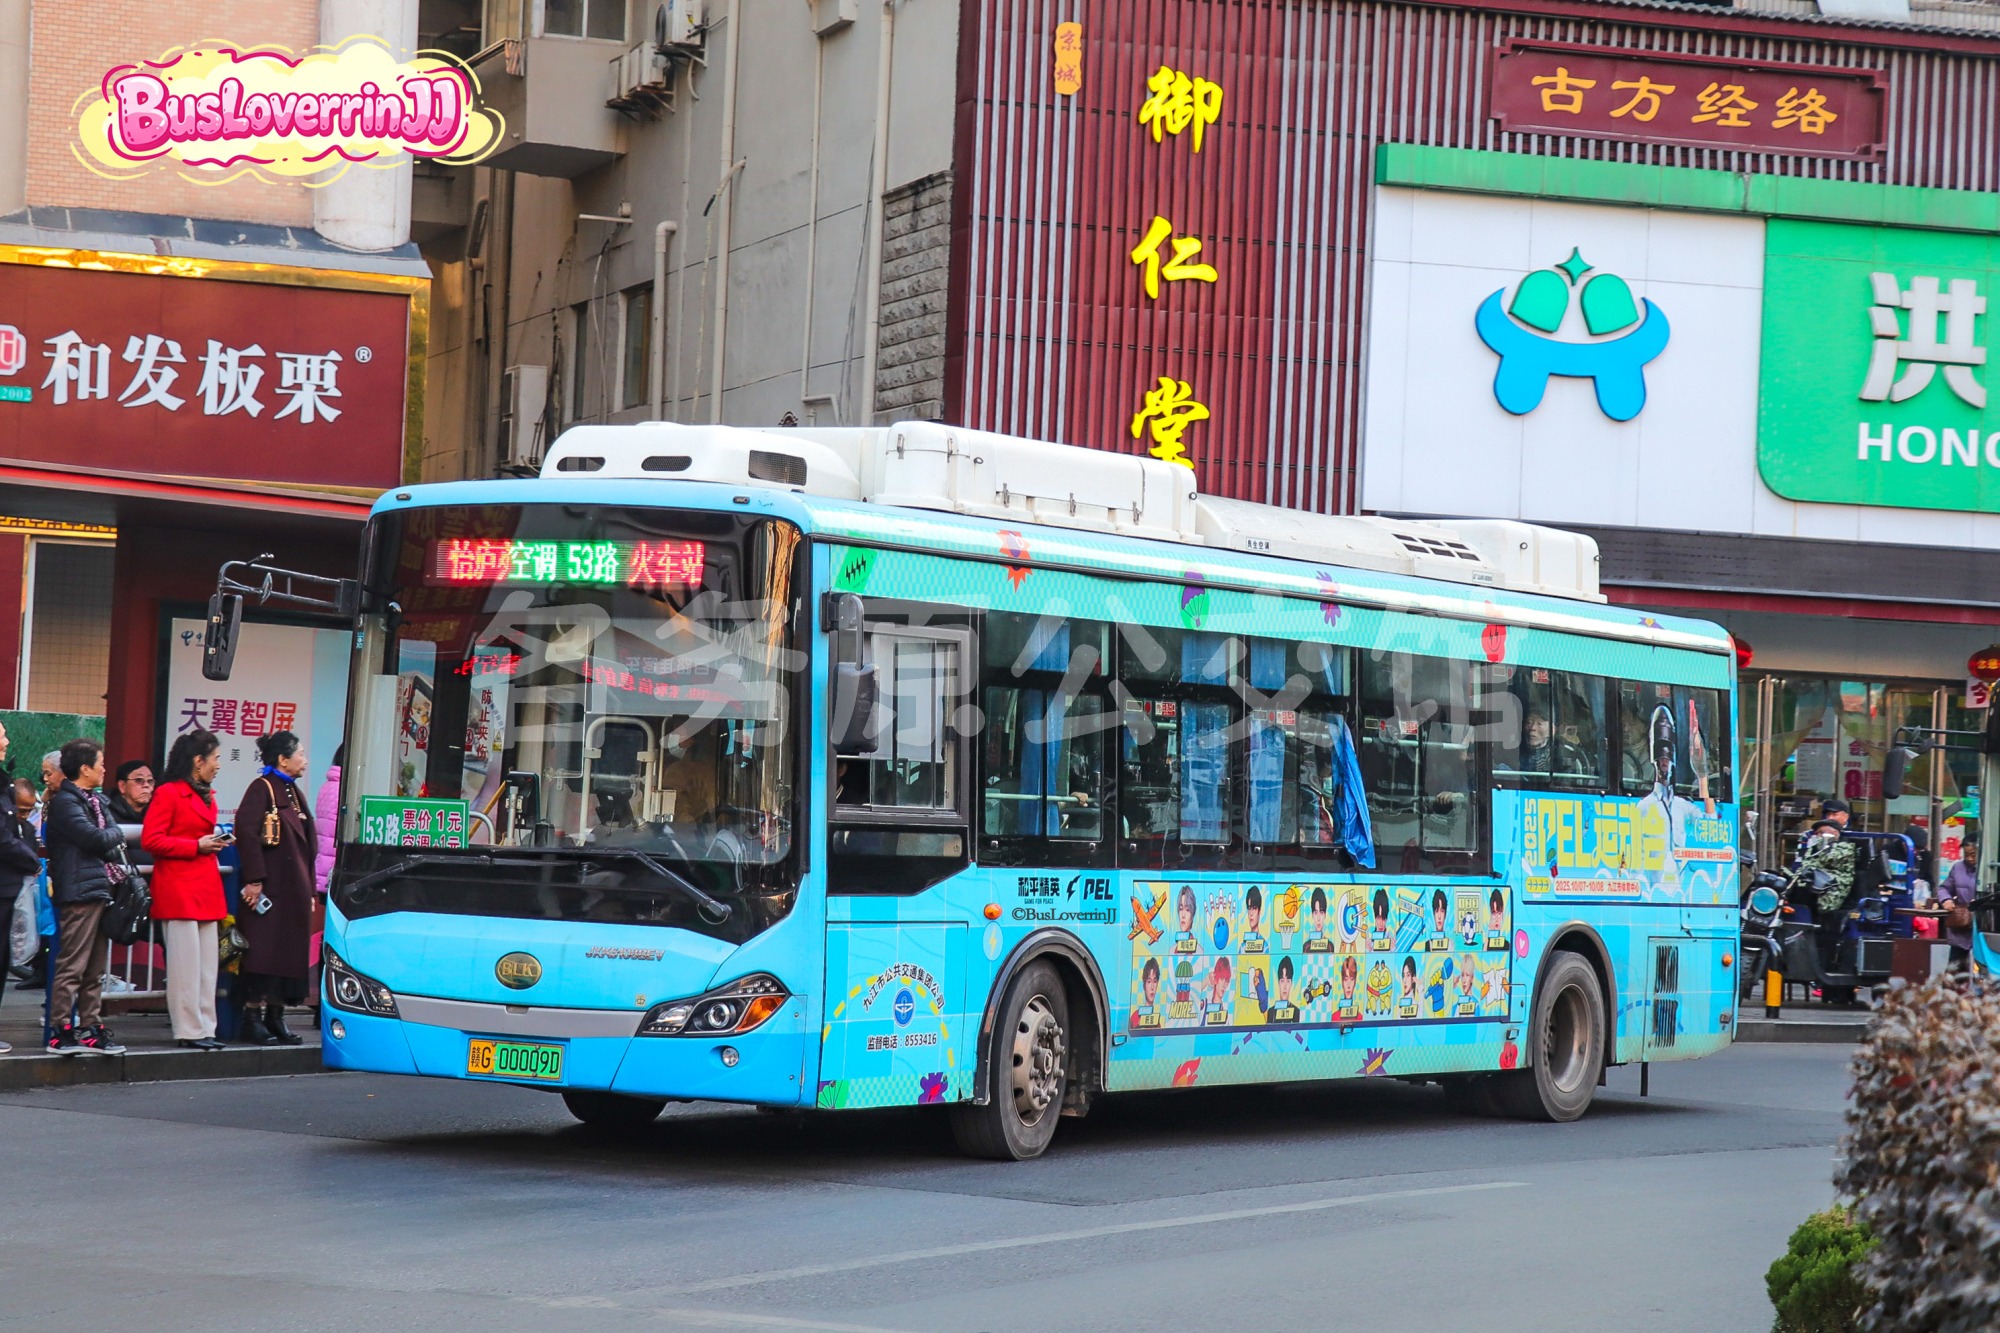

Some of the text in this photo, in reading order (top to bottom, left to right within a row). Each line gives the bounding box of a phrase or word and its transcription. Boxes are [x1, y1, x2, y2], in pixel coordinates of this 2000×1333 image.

[1531, 66, 1838, 135] 古方经络
[1131, 65, 1224, 470] 御仁堂
[1858, 271, 1987, 409] 洪
[41, 329, 343, 425] 和发板栗
[568, 541, 619, 582] 53路
[629, 542, 704, 583] 火车站
[178, 697, 298, 736] 天翼智屏
[365, 813, 400, 846] 53路
[1018, 877, 1060, 897] 和平精英
[501, 961, 534, 977] BLK
[863, 963, 944, 1011] 九江市公共交通集团公司
